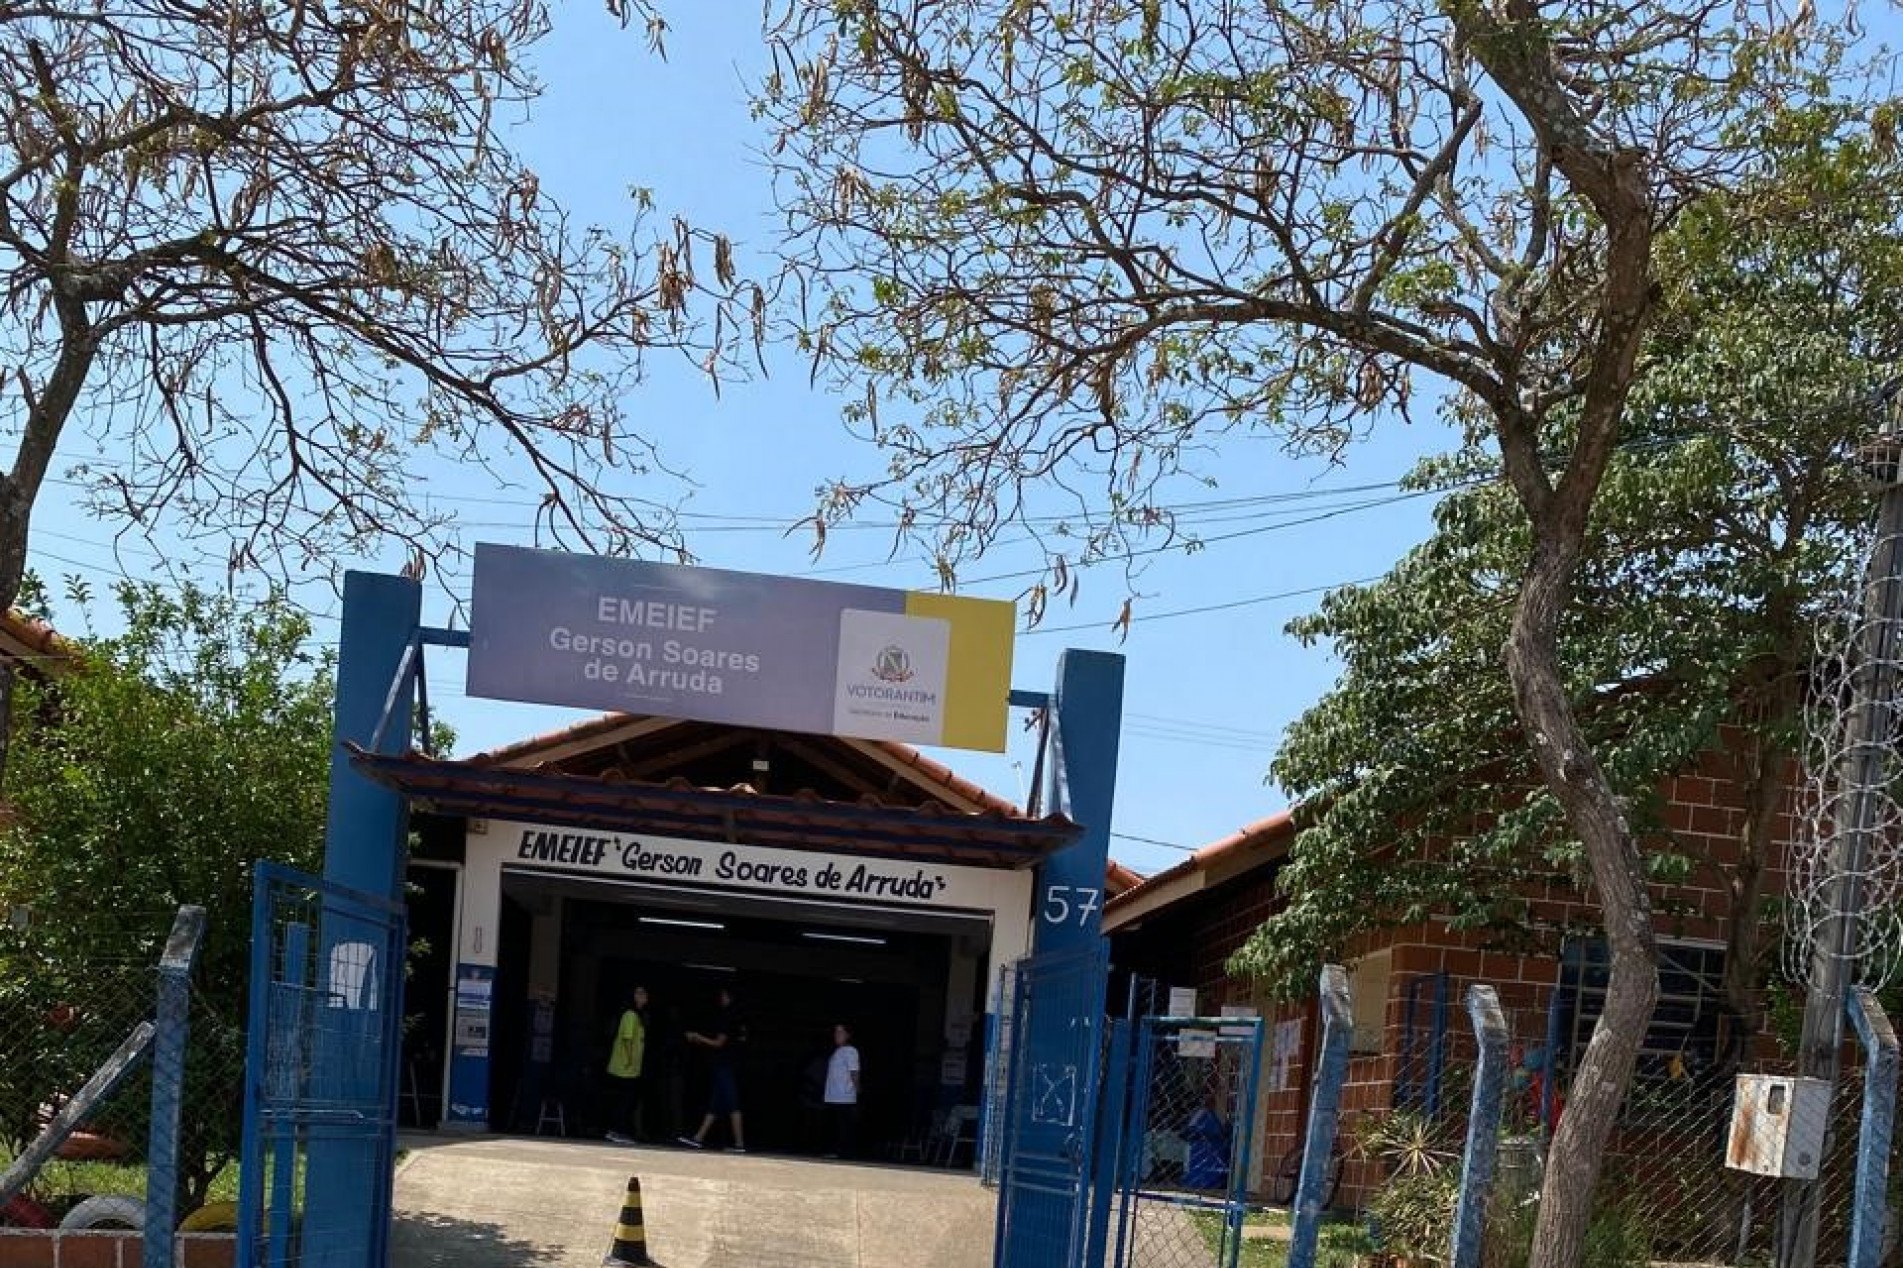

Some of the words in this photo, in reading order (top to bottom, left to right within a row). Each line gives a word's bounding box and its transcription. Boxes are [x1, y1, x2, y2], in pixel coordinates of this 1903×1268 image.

[598, 596, 718, 633] EMEIEF
[550, 626, 651, 660] Gerson
[663, 639, 760, 673] Soares
[584, 658, 619, 682] de
[626, 663, 722, 695] Arruda
[847, 684, 936, 705] VOTORANTIM
[517, 830, 611, 866] EMEIEF
[715, 851, 808, 888] Soares
[814, 861, 842, 890] de
[1044, 885, 1099, 927] 57
